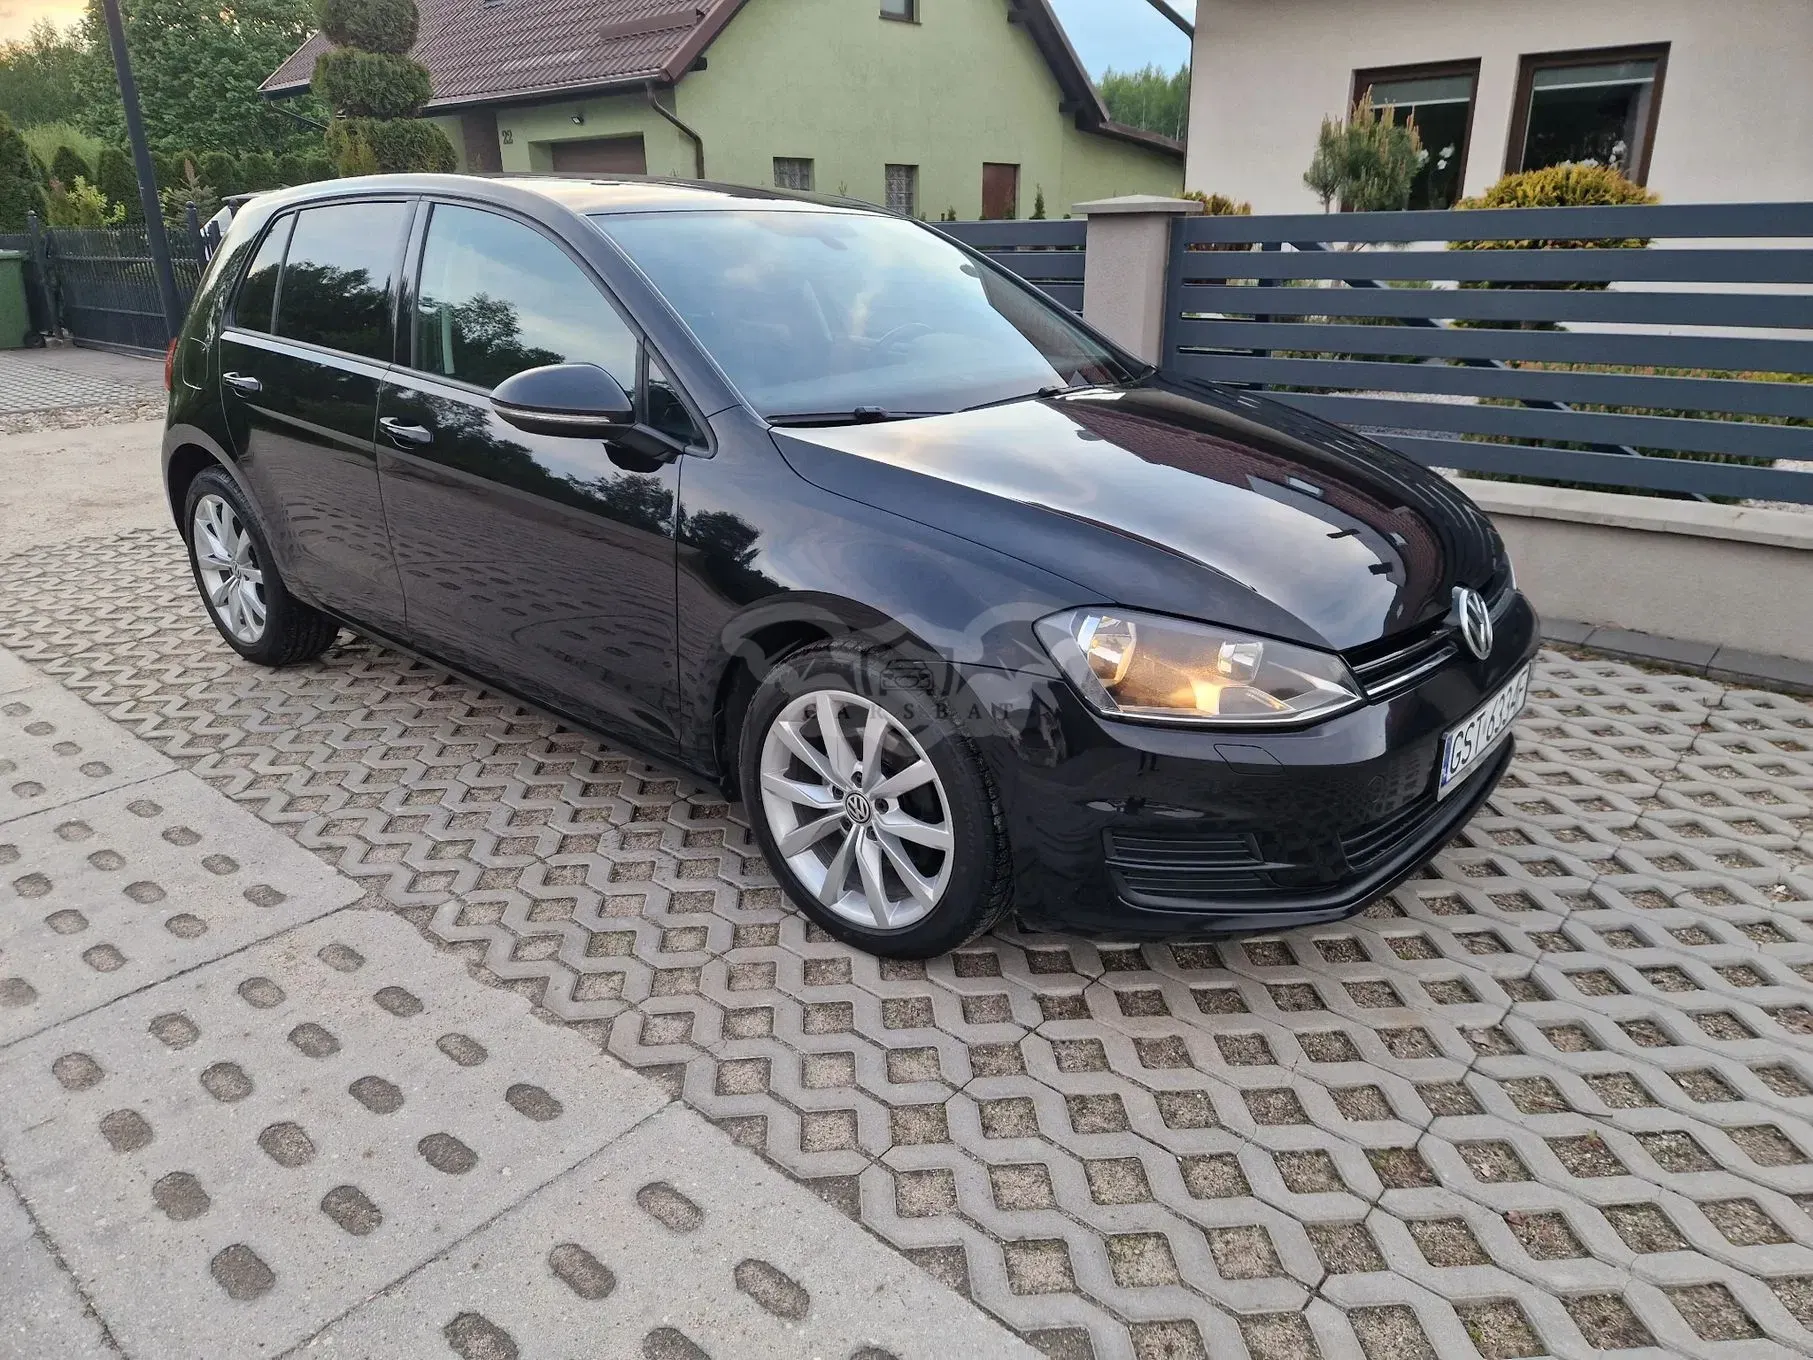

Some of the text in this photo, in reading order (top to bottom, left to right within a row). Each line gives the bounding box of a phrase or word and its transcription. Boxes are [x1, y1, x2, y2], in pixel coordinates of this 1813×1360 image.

[502, 129, 514, 145] 22
[1450, 711, 1486, 774] GST
[846, 793, 871, 823] VW
